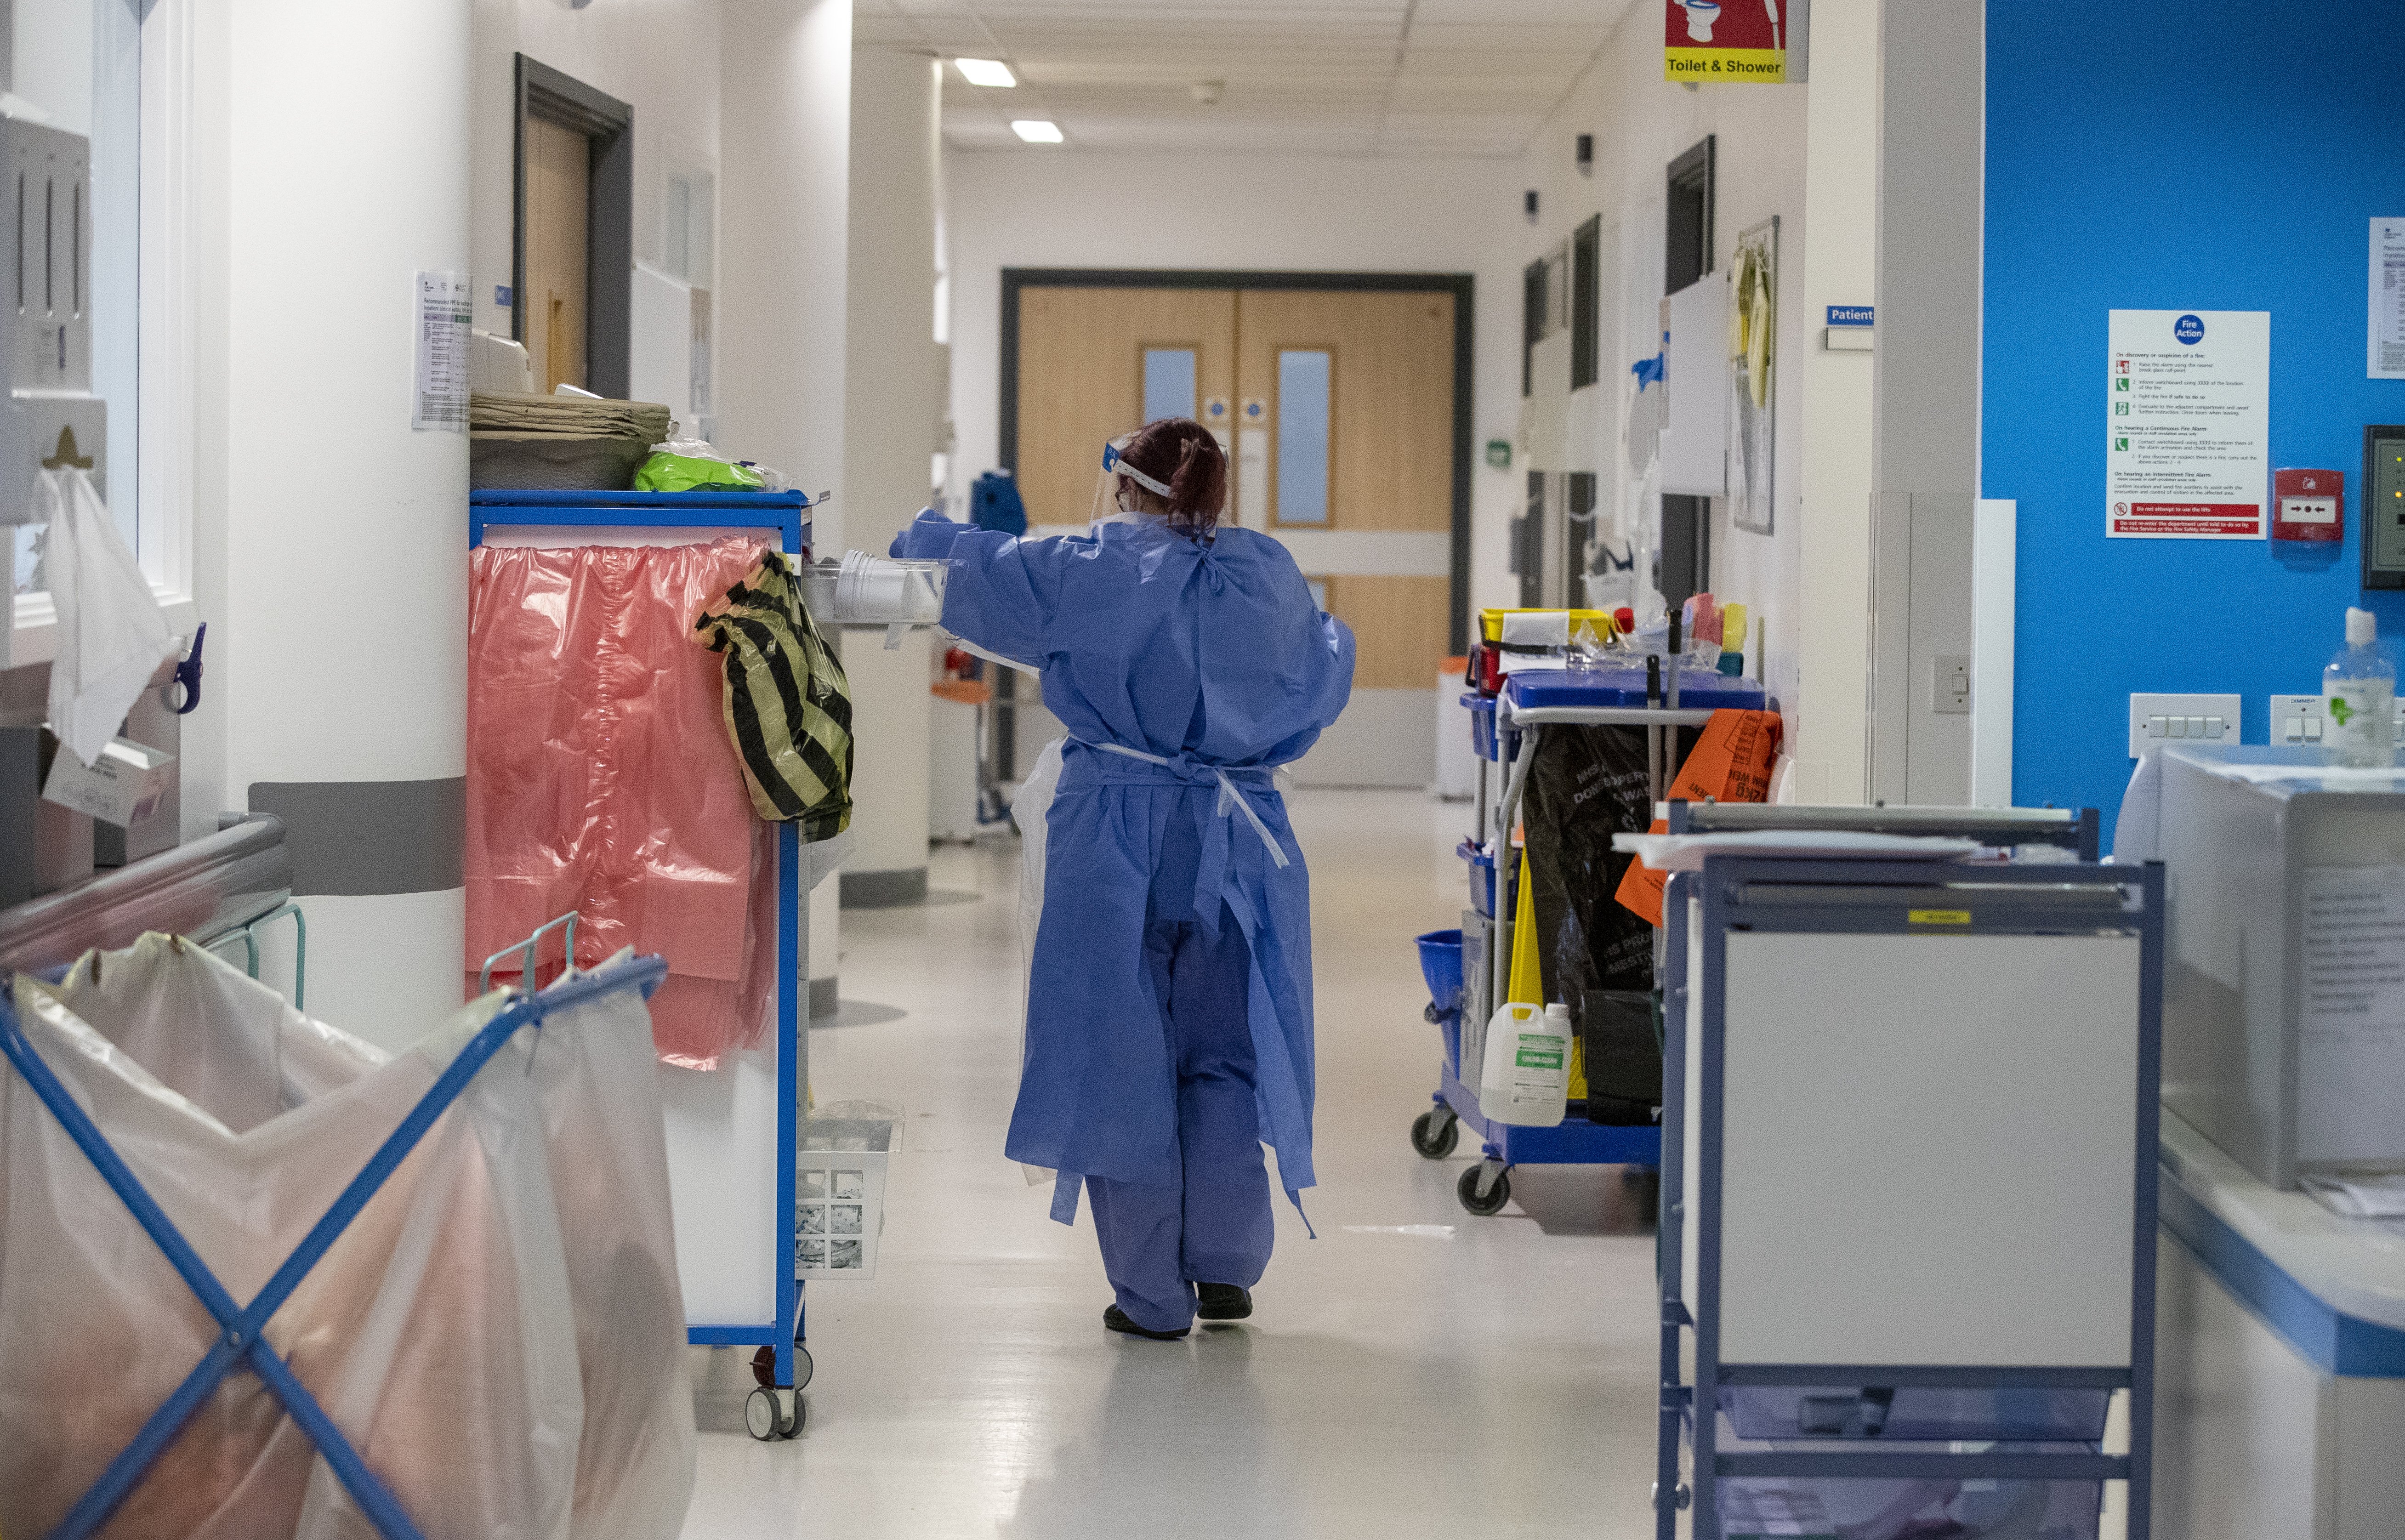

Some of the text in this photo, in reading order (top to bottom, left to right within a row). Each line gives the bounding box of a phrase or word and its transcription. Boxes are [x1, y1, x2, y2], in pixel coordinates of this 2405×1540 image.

[1668, 59, 1781, 73] Toilet & Shower
[1832, 309, 1873, 320] Patient
